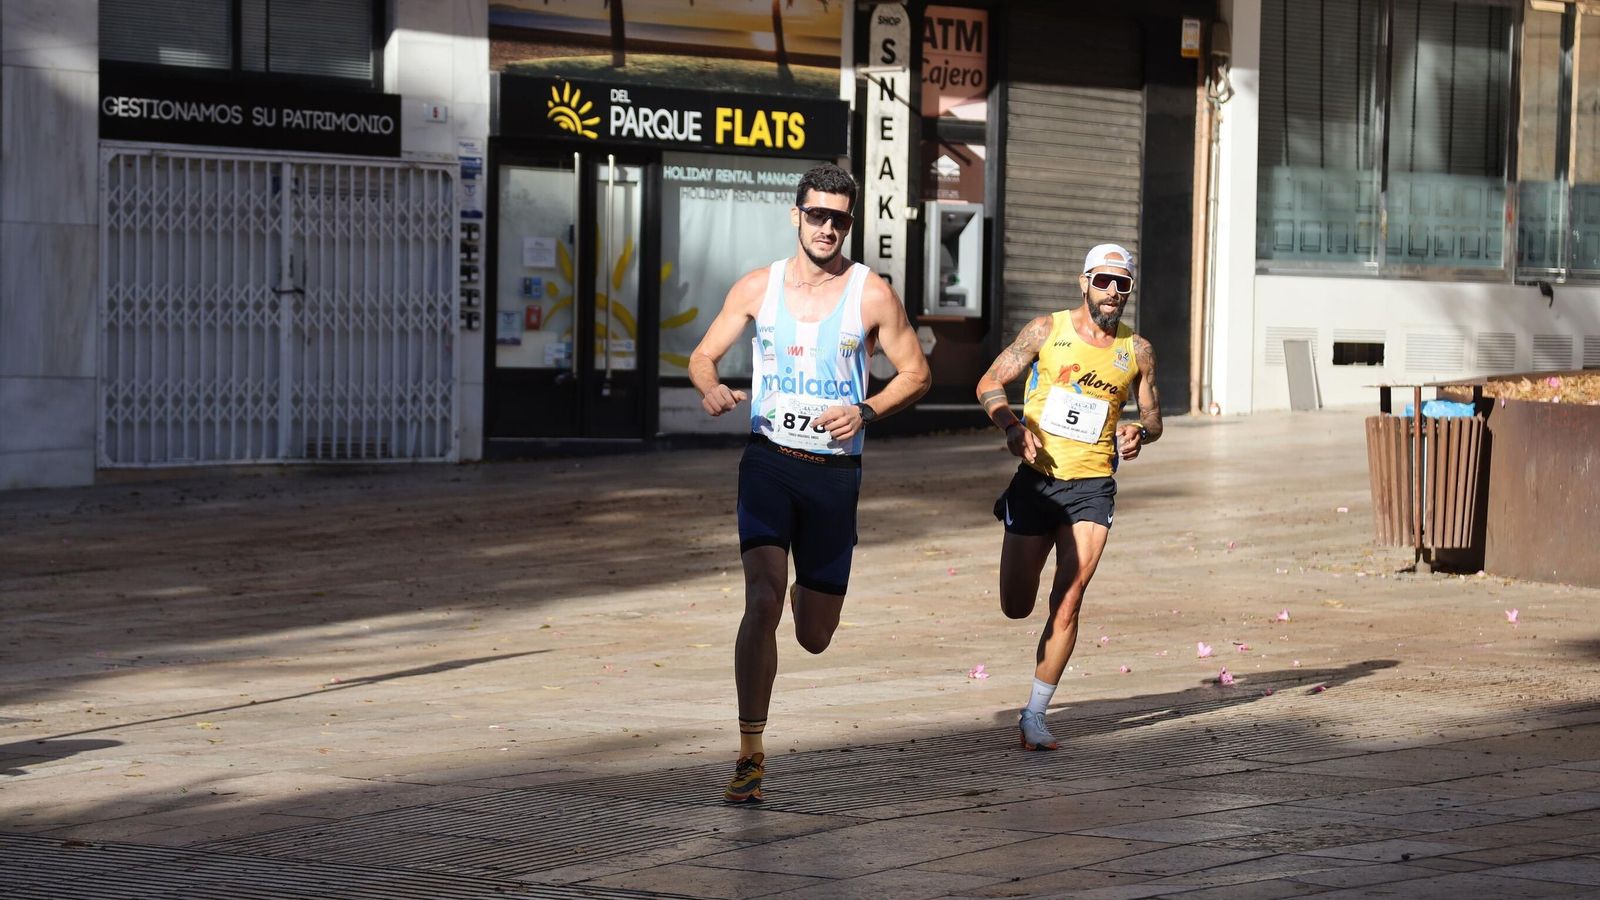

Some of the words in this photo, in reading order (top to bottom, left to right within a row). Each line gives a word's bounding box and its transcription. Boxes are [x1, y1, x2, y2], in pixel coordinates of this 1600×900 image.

[877, 15, 901, 26] SHOP
[923, 16, 983, 53] ATM
[610, 88, 631, 104] DEL
[102, 96, 243, 125] GESTIONAMOS
[252, 107, 276, 127] SU
[283, 109, 394, 135] PATRIMONIO
[610, 106, 702, 143] PARQUE
[715, 107, 806, 150] FLATS
[663, 165, 714, 181] HOLIDAY
[716, 168, 755, 184] RENTAL
[1054, 340, 1072, 348] vive
[1077, 370, 1119, 395] Álora
[1065, 409, 1081, 425] 5
[779, 446, 826, 462] WONG
